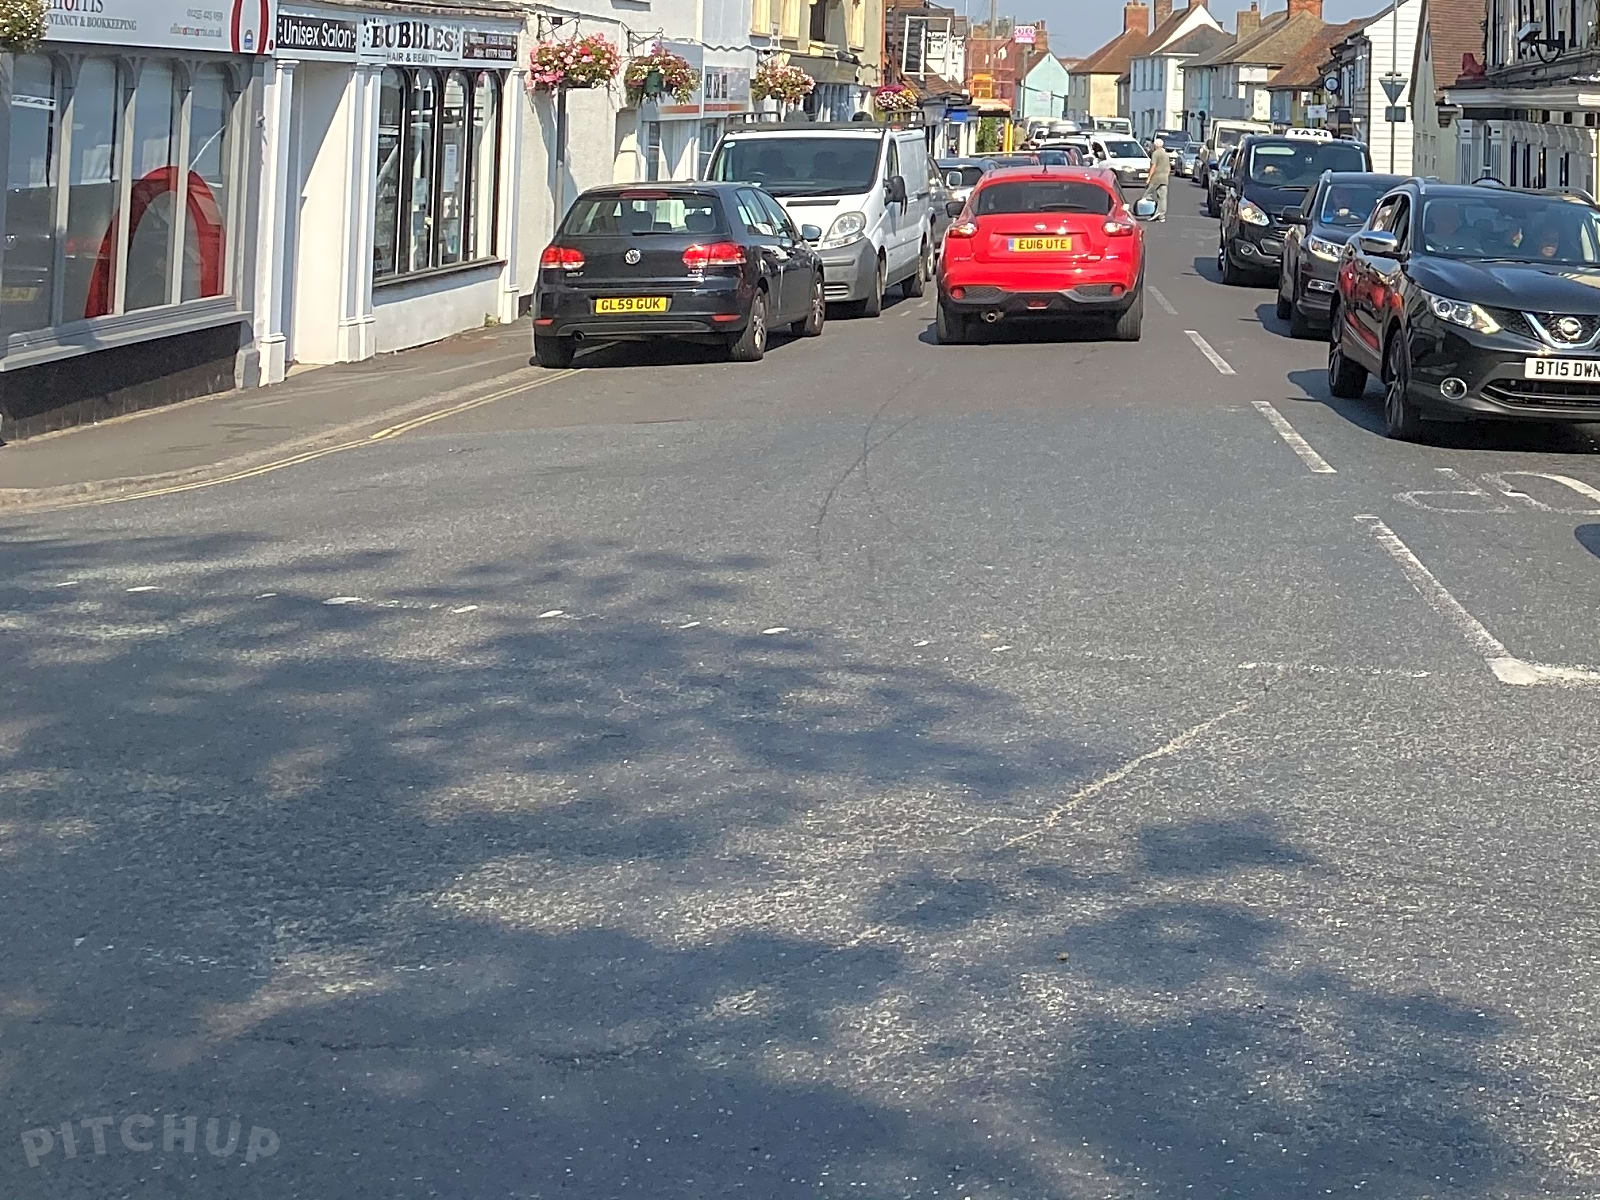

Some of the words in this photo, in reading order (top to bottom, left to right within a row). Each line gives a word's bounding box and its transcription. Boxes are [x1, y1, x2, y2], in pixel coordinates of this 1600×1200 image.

[47, 13, 79, 27] NTANCY
[79, 16, 86, 27] &
[86, 17, 137, 30] BOOKKEEPING
[283, 18, 320, 47] Unisex
[321, 21, 351, 49] Salon
[371, 20, 454, 53] BUBBLES
[387, 52, 404, 62] HAIR
[405, 53, 411, 62] &
[412, 53, 438, 63] BEAUTY
[1292, 128, 1329, 139] TAXI
[1018, 239, 1043, 249] EU16
[1046, 239, 1067, 249] UTE
[601, 297, 634, 310] GL59
[636, 297, 660, 310] GUK
[1535, 360, 1570, 376] BT15
